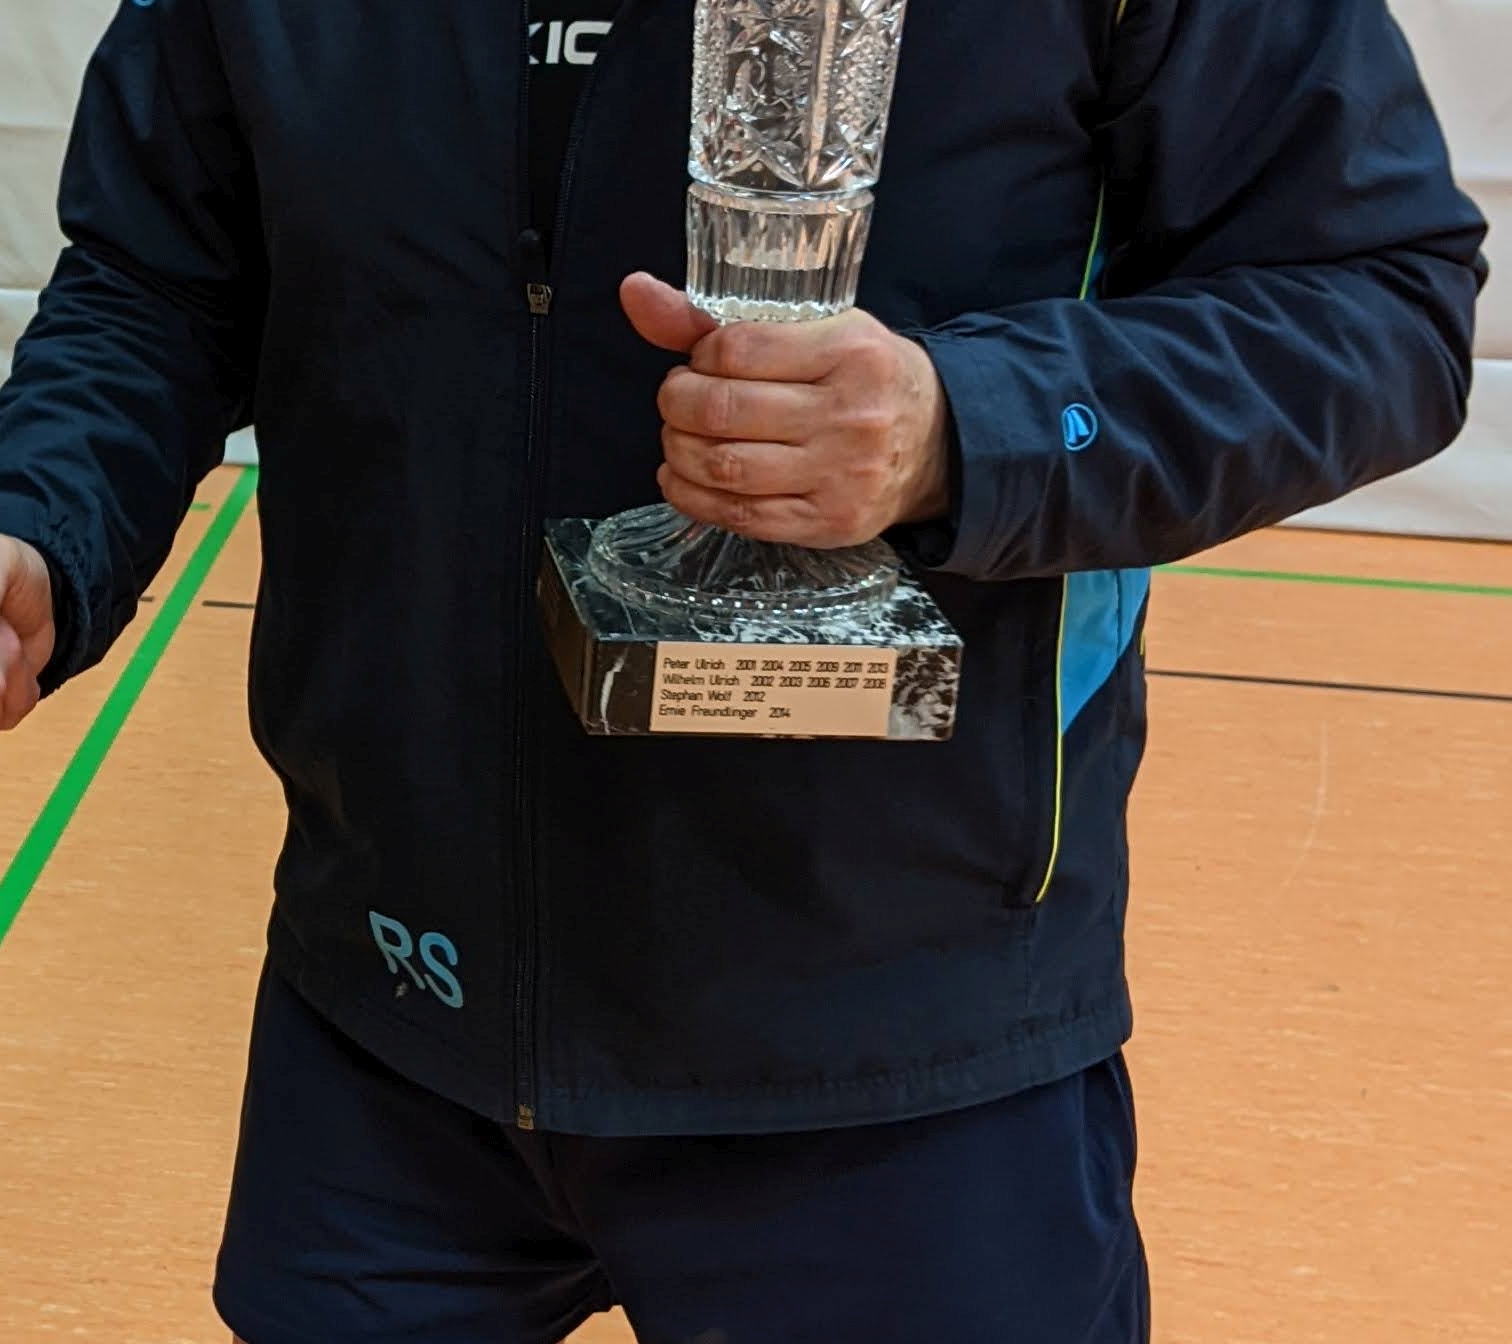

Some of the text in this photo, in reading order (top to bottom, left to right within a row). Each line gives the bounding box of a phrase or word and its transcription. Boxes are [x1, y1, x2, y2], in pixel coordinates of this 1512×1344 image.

[663, 657, 690, 669] Peter
[695, 658, 725, 670] Ulrich
[760, 660, 784, 672] 2004
[662, 673, 705, 686] Wilhelm
[709, 674, 740, 686] Ulrich
[751, 675, 775, 687] 2002
[834, 677, 859, 689] 2007
[660, 689, 766, 703] Stephan Wolf 2012
[369, 911, 464, 1009] RS
